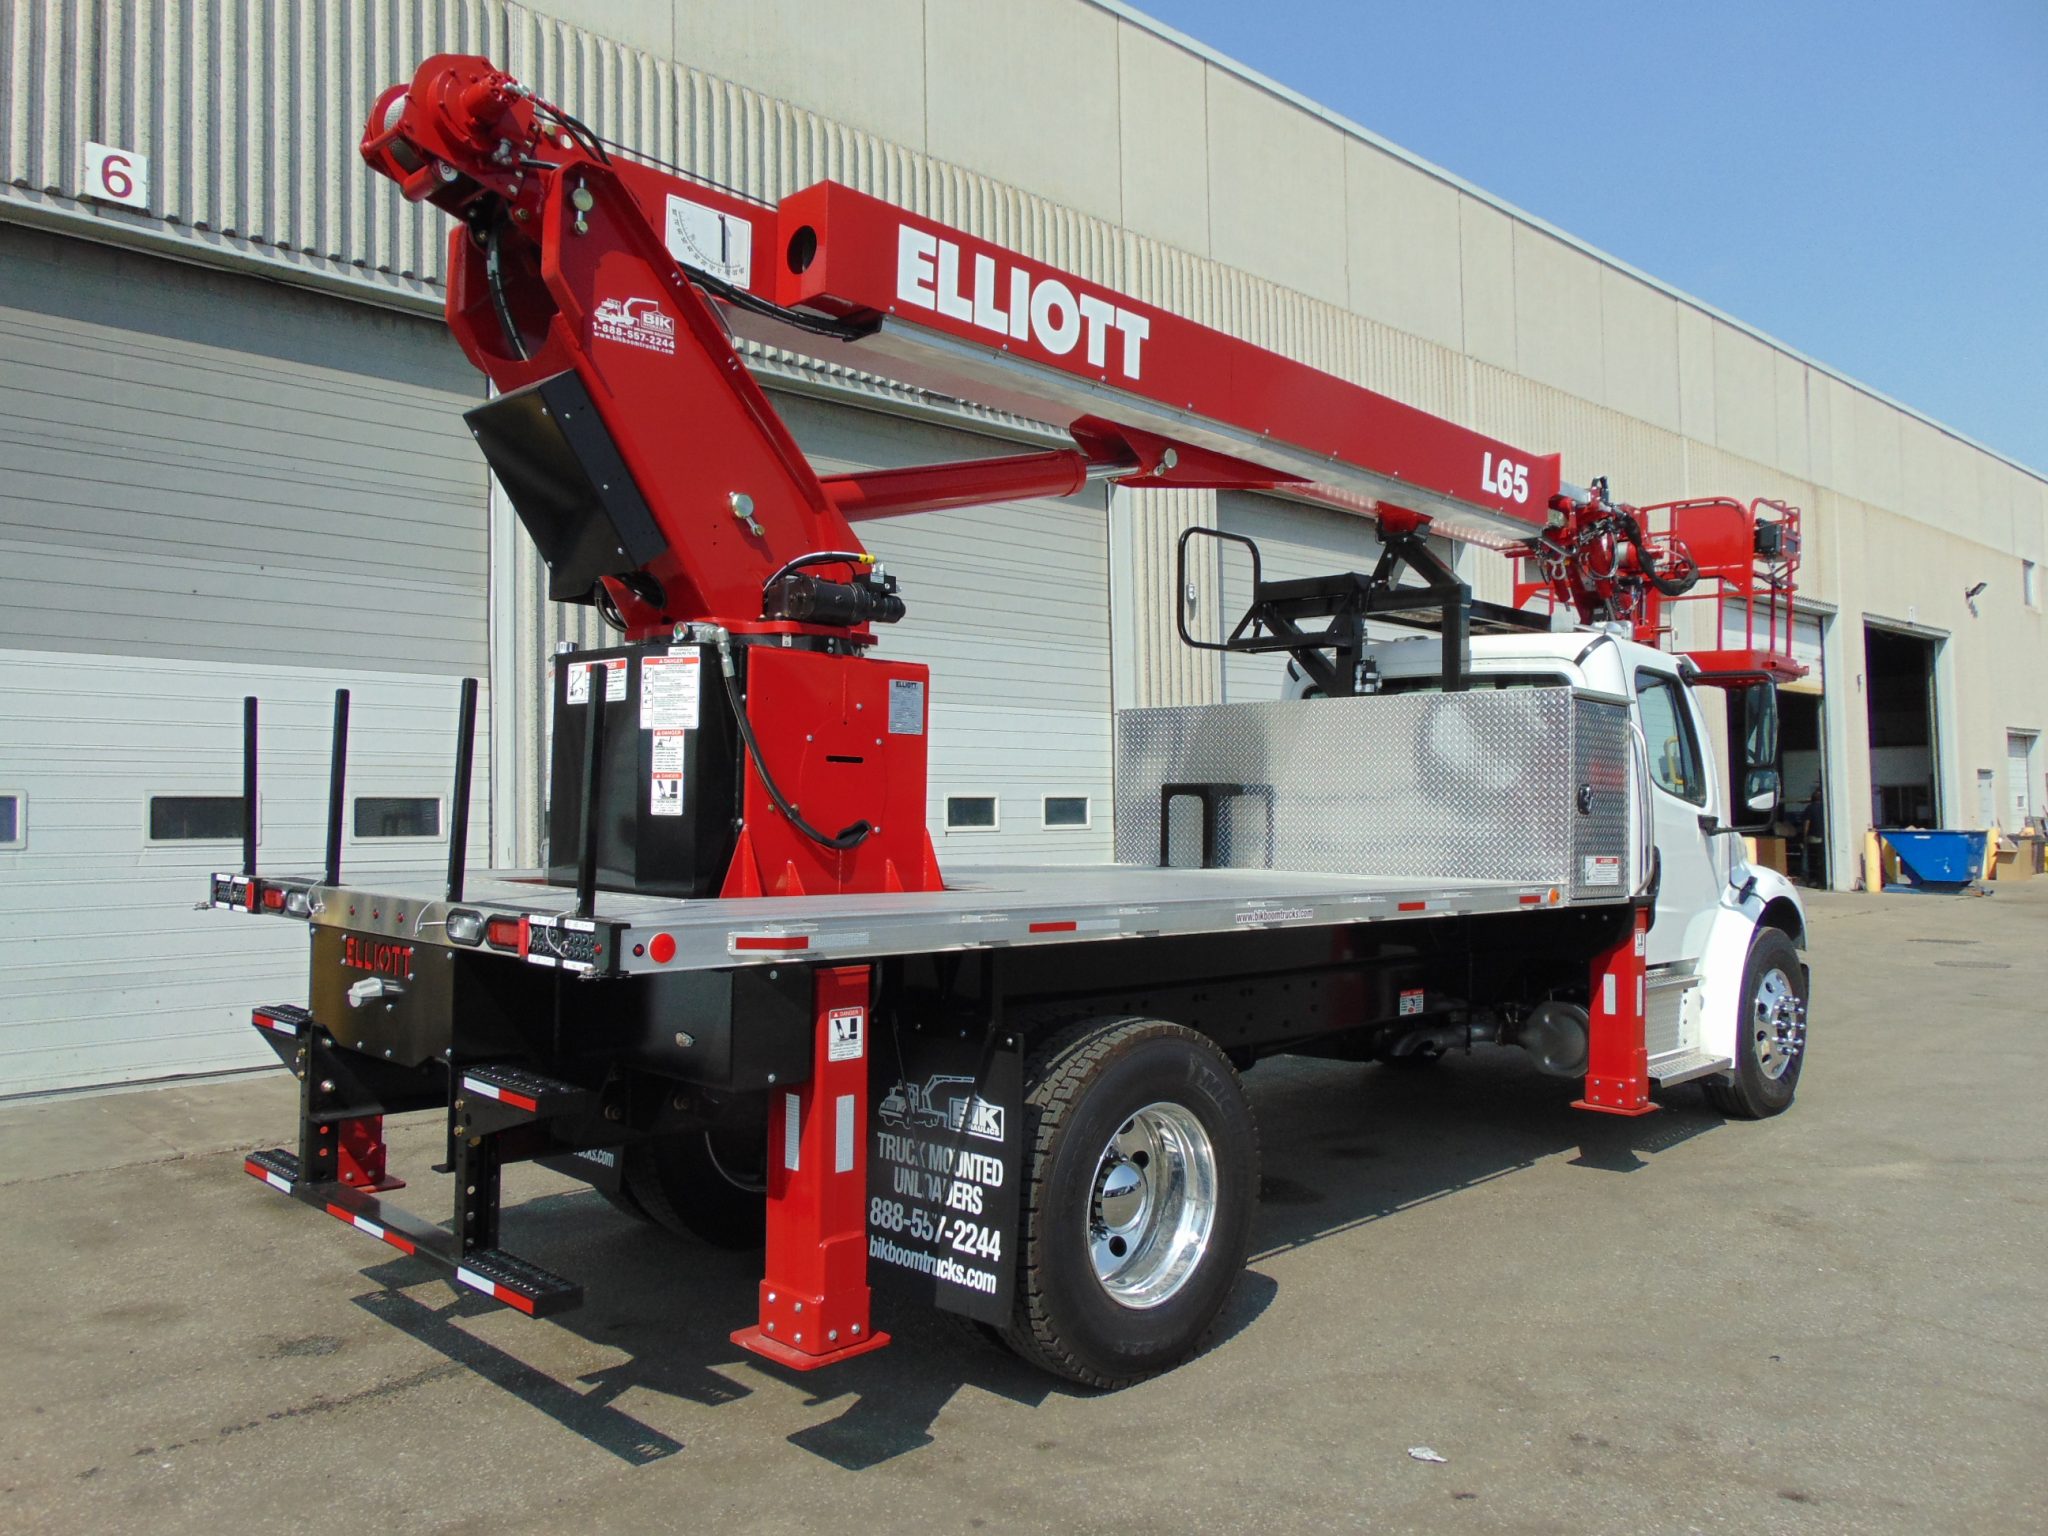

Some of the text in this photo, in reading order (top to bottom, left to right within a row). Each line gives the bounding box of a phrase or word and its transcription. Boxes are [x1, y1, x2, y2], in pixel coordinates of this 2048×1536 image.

[101, 154, 132, 198] 6
[643, 313, 671, 329] BIK
[897, 223, 1150, 380] ELLIOTT
[592, 321, 675, 348] 1-888-557-2244
[1482, 451, 1528, 504] L65
[1236, 908, 1313, 922] www.bikboomtrucks.com
[346, 937, 413, 977] ELLIOTT
[870, 1197, 1001, 1262] 888-557-2244
[869, 1235, 997, 1294] bikboomtrucks.com
